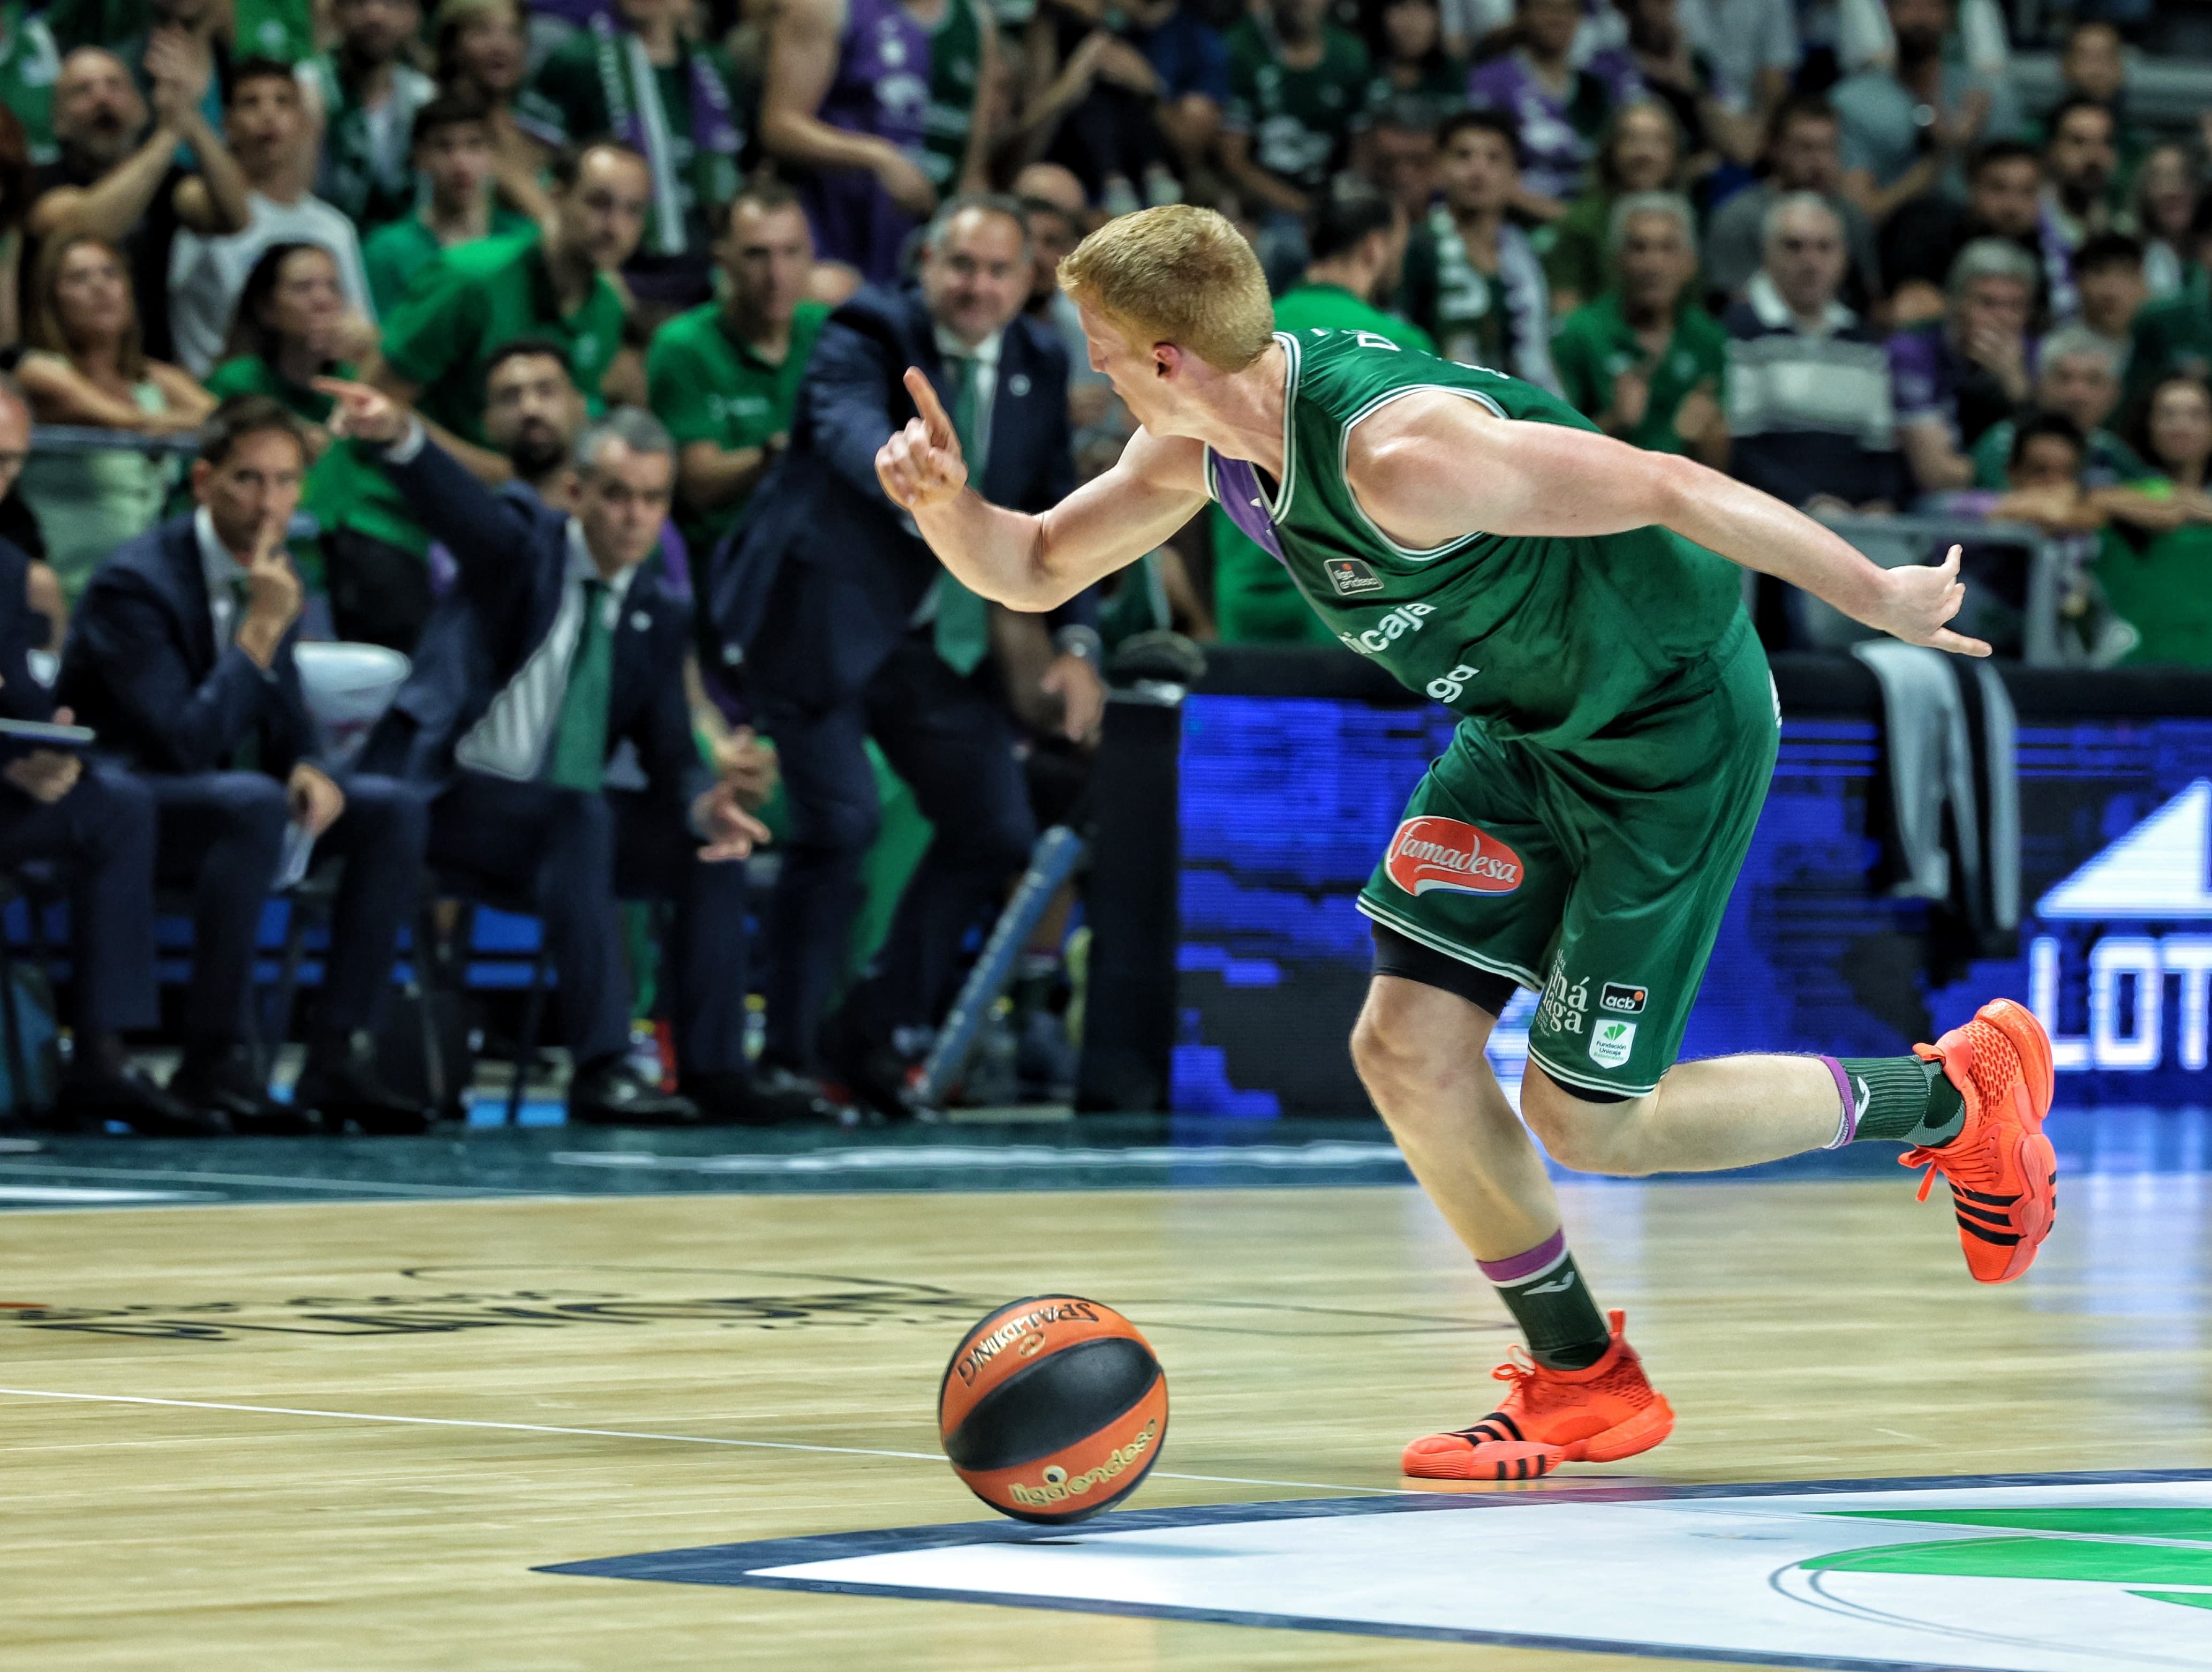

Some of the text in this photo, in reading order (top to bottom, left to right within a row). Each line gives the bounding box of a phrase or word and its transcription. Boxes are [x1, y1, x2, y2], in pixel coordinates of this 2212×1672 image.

[1606, 996, 1635, 1010] acb
[1596, 1041, 1627, 1050] Fundación
[1599, 1048, 1621, 1056] Unicaja
[957, 1302, 1099, 1387] SPALDING
